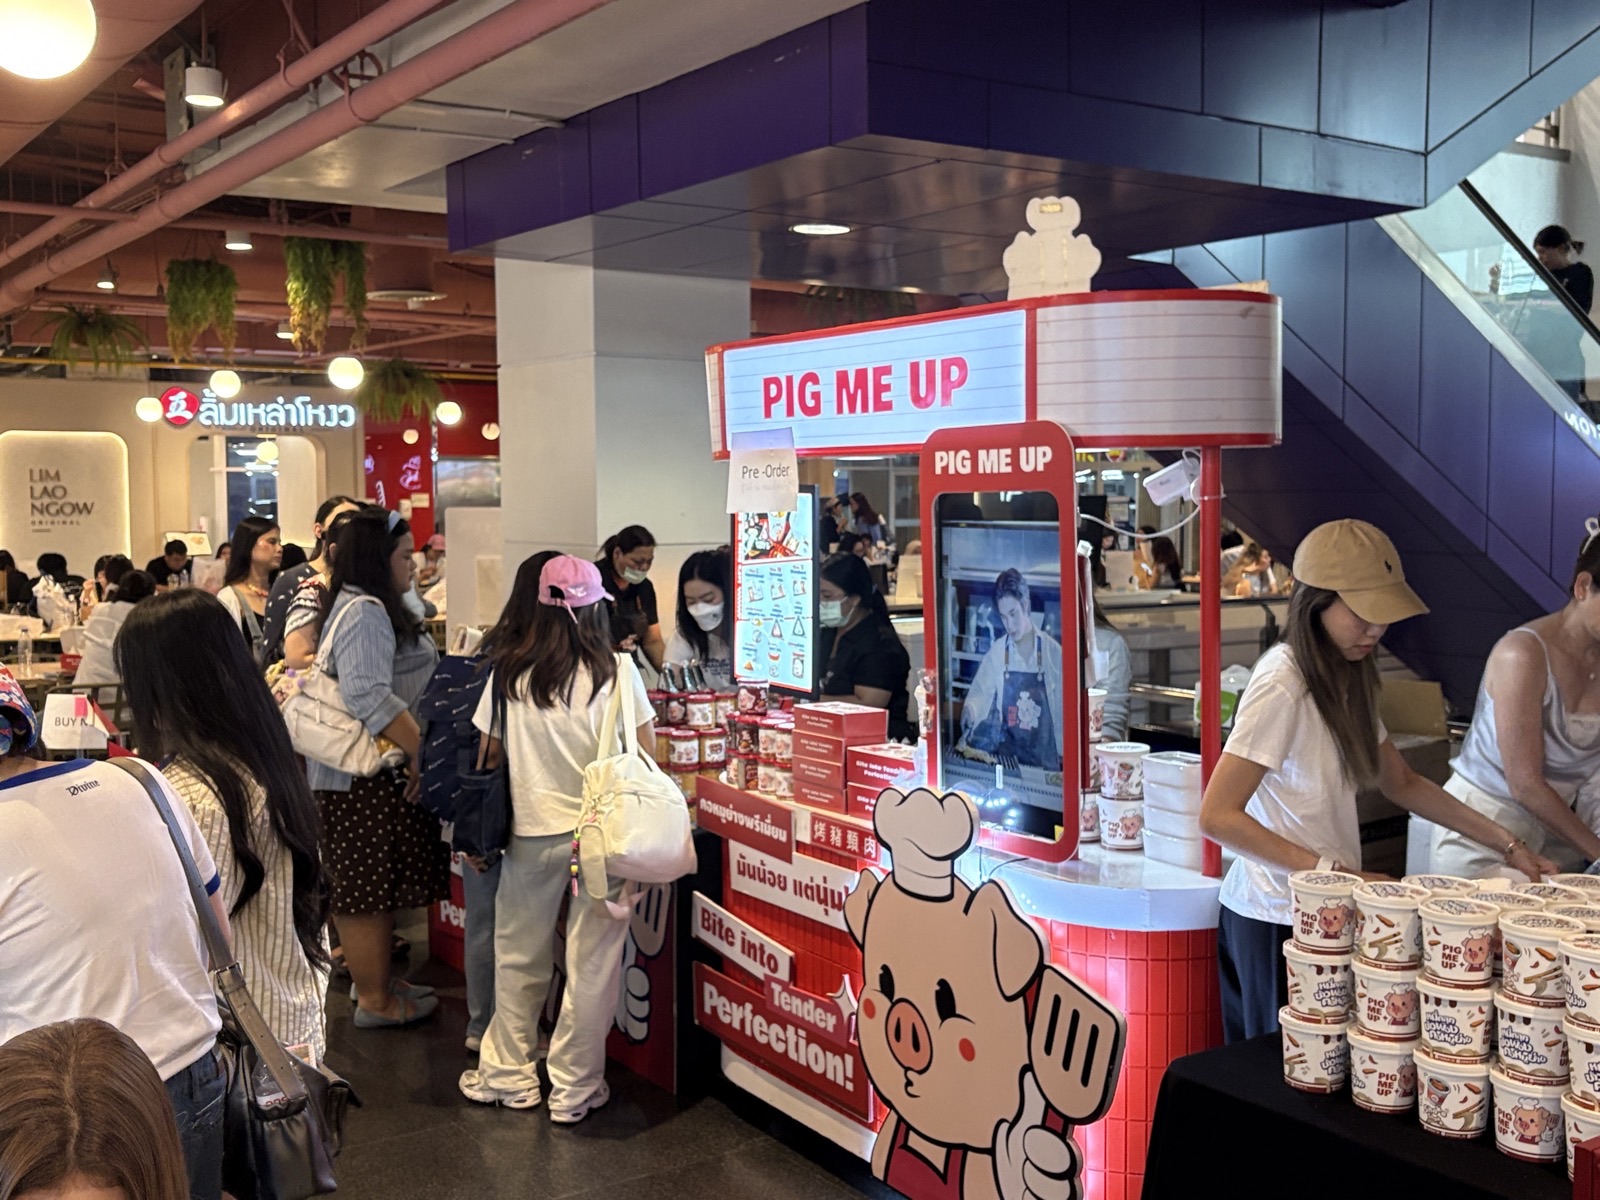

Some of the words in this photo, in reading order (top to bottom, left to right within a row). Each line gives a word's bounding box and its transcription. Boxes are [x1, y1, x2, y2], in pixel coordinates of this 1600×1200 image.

[763, 371, 822, 420] PIG
[835, 364, 893, 415] ME
[909, 355, 969, 409] UP
[935, 448, 972, 475] PIG
[977, 447, 1015, 474] ME
[1020, 445, 1053, 472] UP
[29, 468, 61, 483] LIM
[741, 465, 759, 479] Pre
[29, 485, 67, 500] LAO
[30, 501, 94, 517] NGOW
[54, 716, 77, 727] BUY
[855, 760, 868, 768] Bite
[868, 762, 882, 771] into
[65, 779, 101, 796] Divine
[856, 795, 870, 803] Bite
[736, 852, 788, 892] มันน้อย
[793, 875, 849, 917] แต่นุ่ม
[1301, 911, 1318, 921] PIG
[1301, 919, 1315, 929] ME
[1300, 926, 1314, 936] UP
[700, 907, 736, 948] Bite
[740, 930, 780, 975] into
[1442, 943, 1462, 955] PIG
[1441, 952, 1459, 963] ME
[1441, 961, 1457, 970] UP
[1367, 997, 1385, 1008] PIG
[770, 983, 837, 1034] Tender
[1367, 1005, 1382, 1015] ME
[1366, 1013, 1381, 1023] UP
[702, 980, 855, 1093] Perfection!
[1377, 1071, 1397, 1082] PIG
[1377, 1080, 1394, 1090] ME
[1376, 1088, 1392, 1097] UP
[1497, 1108, 1513, 1122] PIG
[1497, 1118, 1511, 1130] ME
[1497, 1126, 1509, 1136] UP
